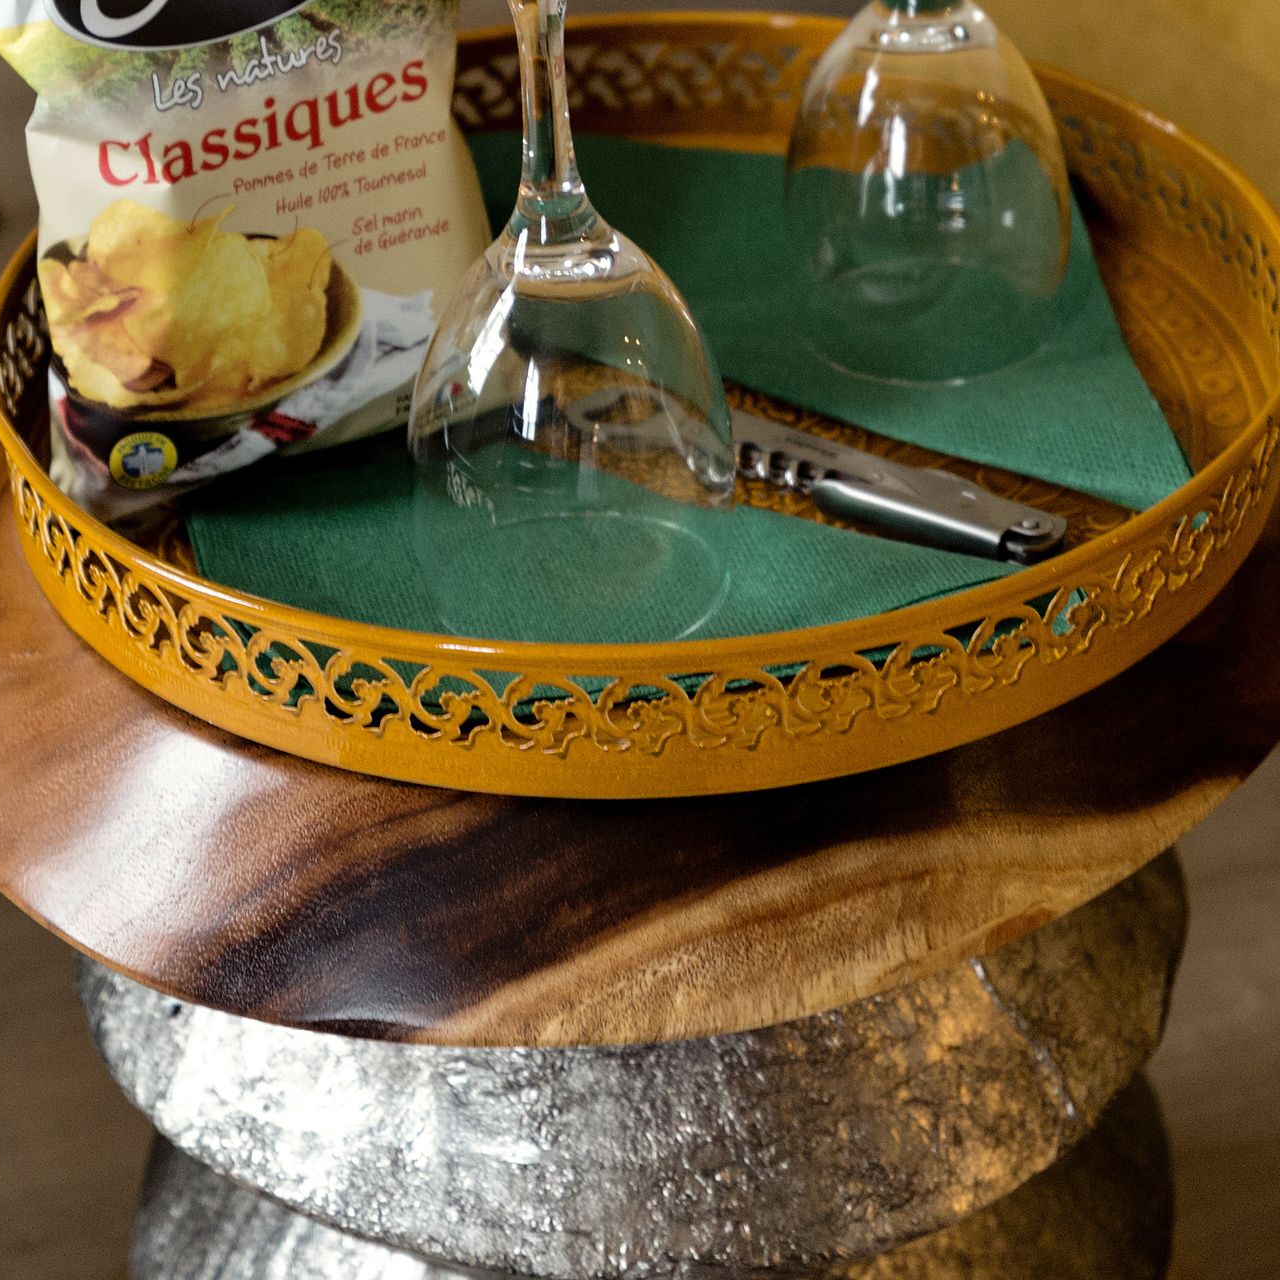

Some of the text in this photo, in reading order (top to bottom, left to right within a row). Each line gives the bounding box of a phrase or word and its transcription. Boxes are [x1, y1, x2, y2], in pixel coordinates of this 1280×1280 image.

[152, 28, 342, 111] Les natures
[98, 58, 428, 187] Classiques
[233, 128, 446, 195] Pommes de Terre de France
[276, 161, 426, 215] Huile 100% Tournesol
[351, 206, 422, 236] Sel marin
[354, 219, 450, 256] de Guérande
